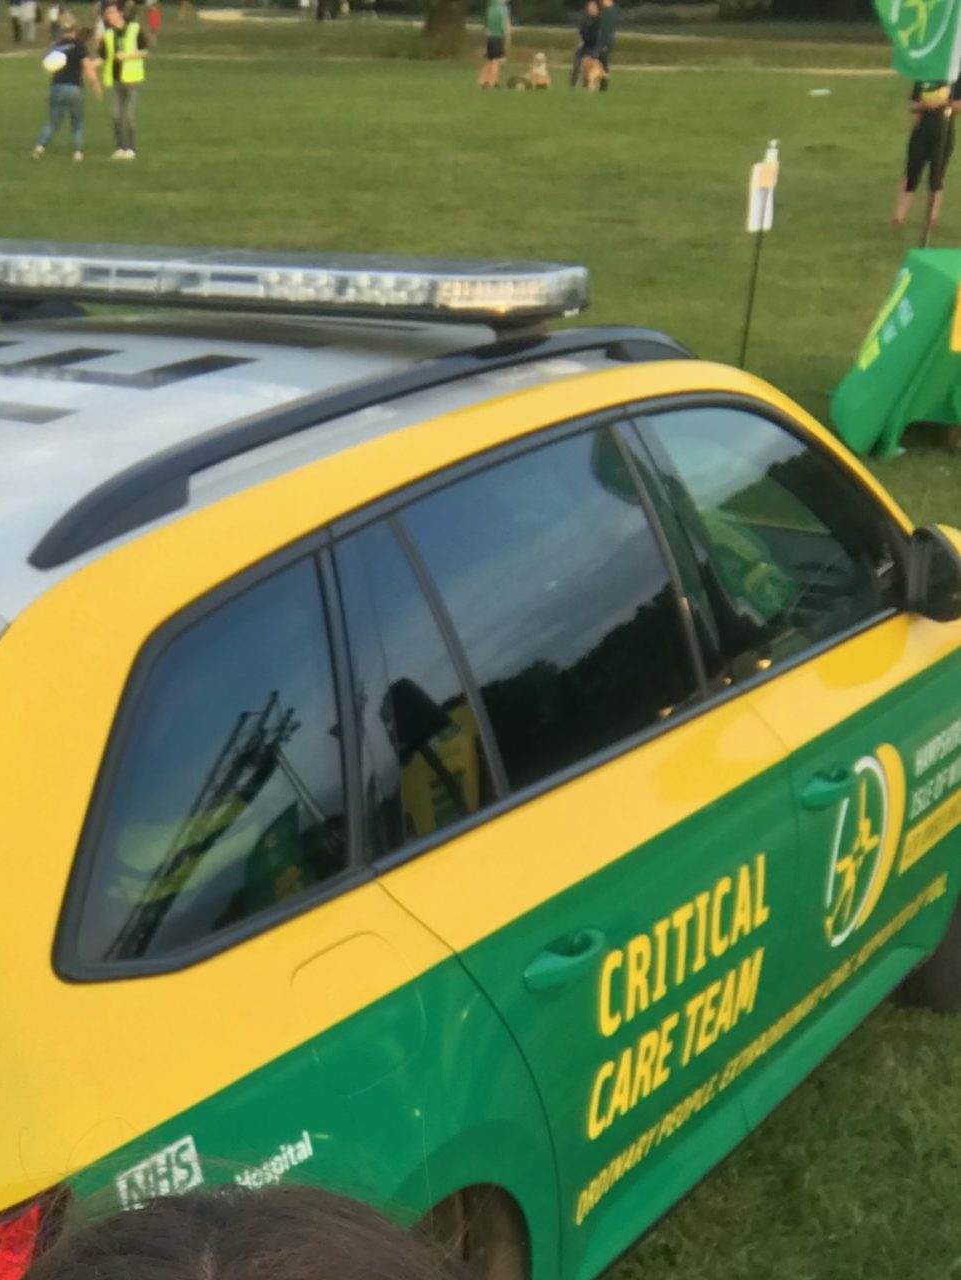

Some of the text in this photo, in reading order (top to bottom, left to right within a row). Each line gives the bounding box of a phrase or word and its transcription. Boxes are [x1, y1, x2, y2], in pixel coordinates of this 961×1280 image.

[599, 853, 770, 1037] CRITICAL
[587, 1012, 680, 1140] CARE
[681, 946, 765, 1067] TEAM
[124, 1142, 197, 1200] NHS
